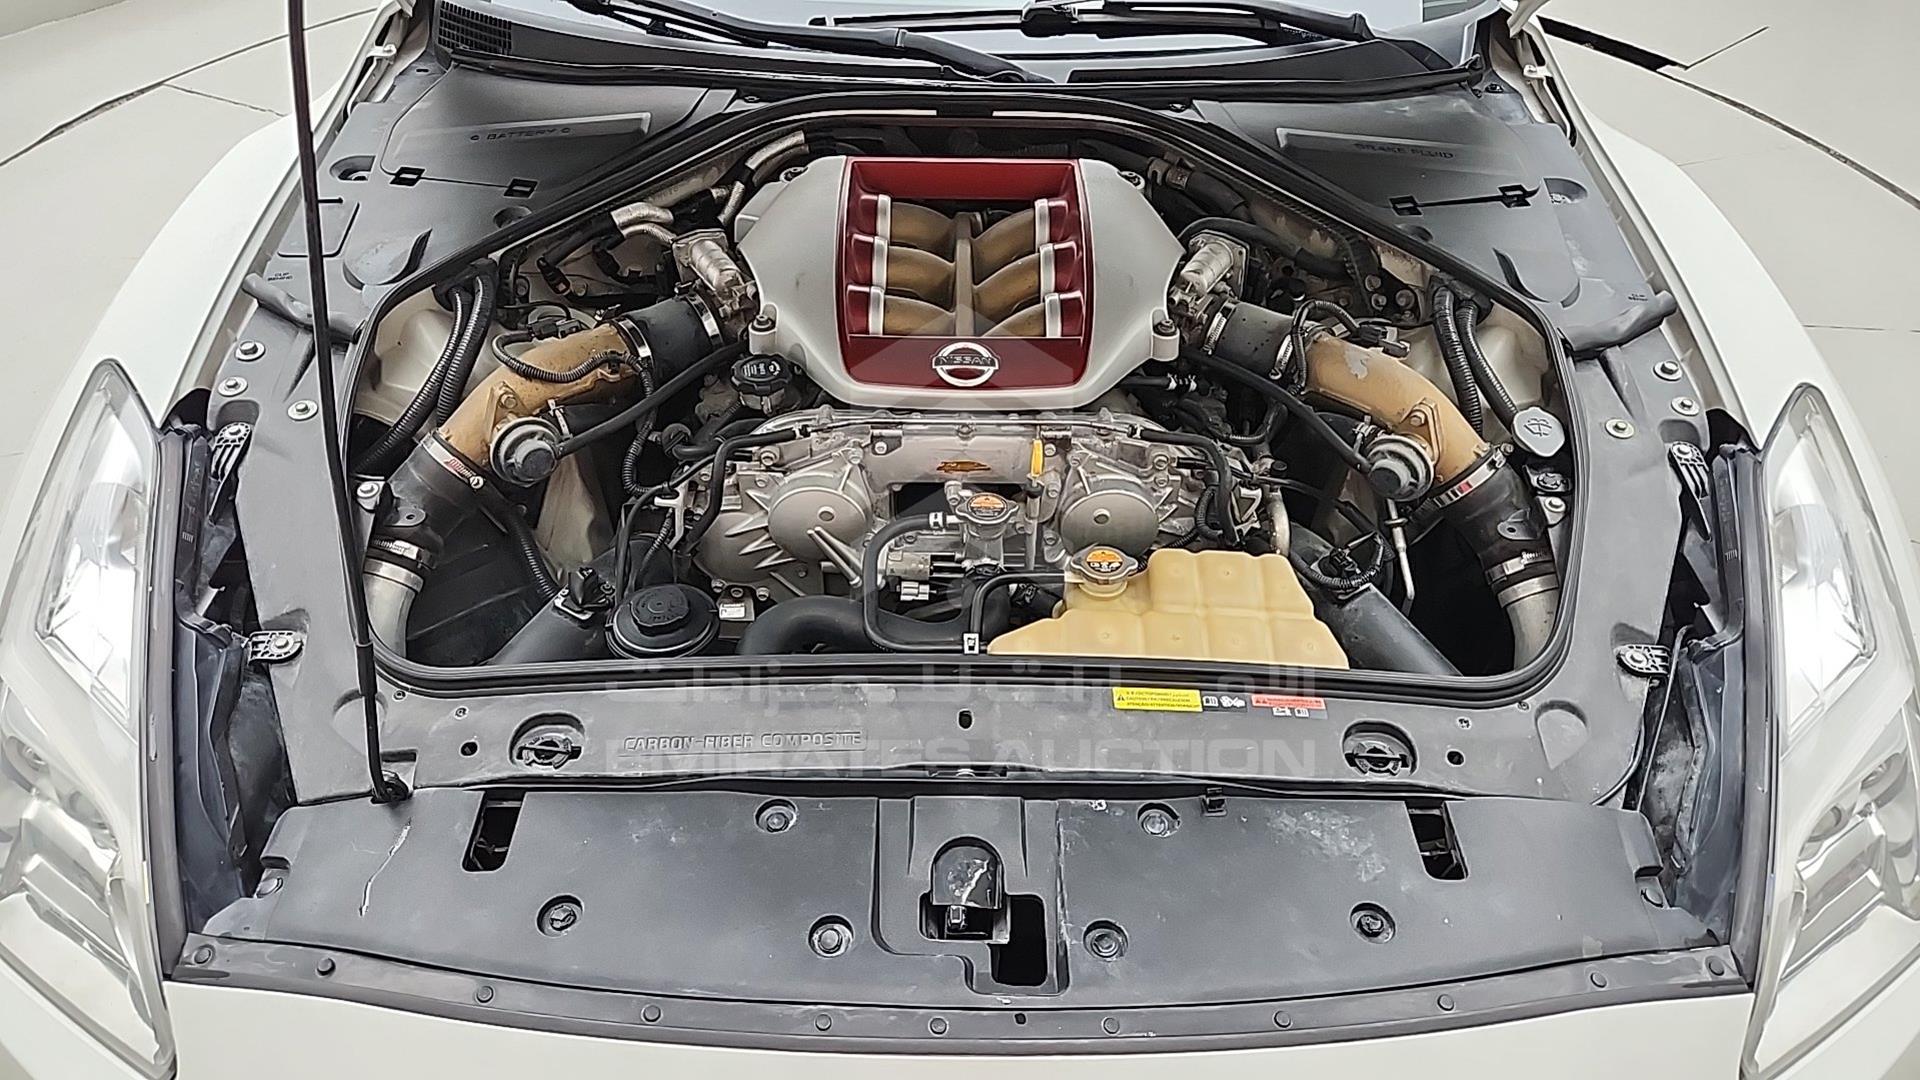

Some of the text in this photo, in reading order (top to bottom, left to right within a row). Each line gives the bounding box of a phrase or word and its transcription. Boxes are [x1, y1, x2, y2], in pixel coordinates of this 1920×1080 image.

[487, 127, 557, 140] BATTERY
[938, 356, 992, 366] NISSAN
[623, 731, 862, 751] CARBON-FIBER COMPOSITE
